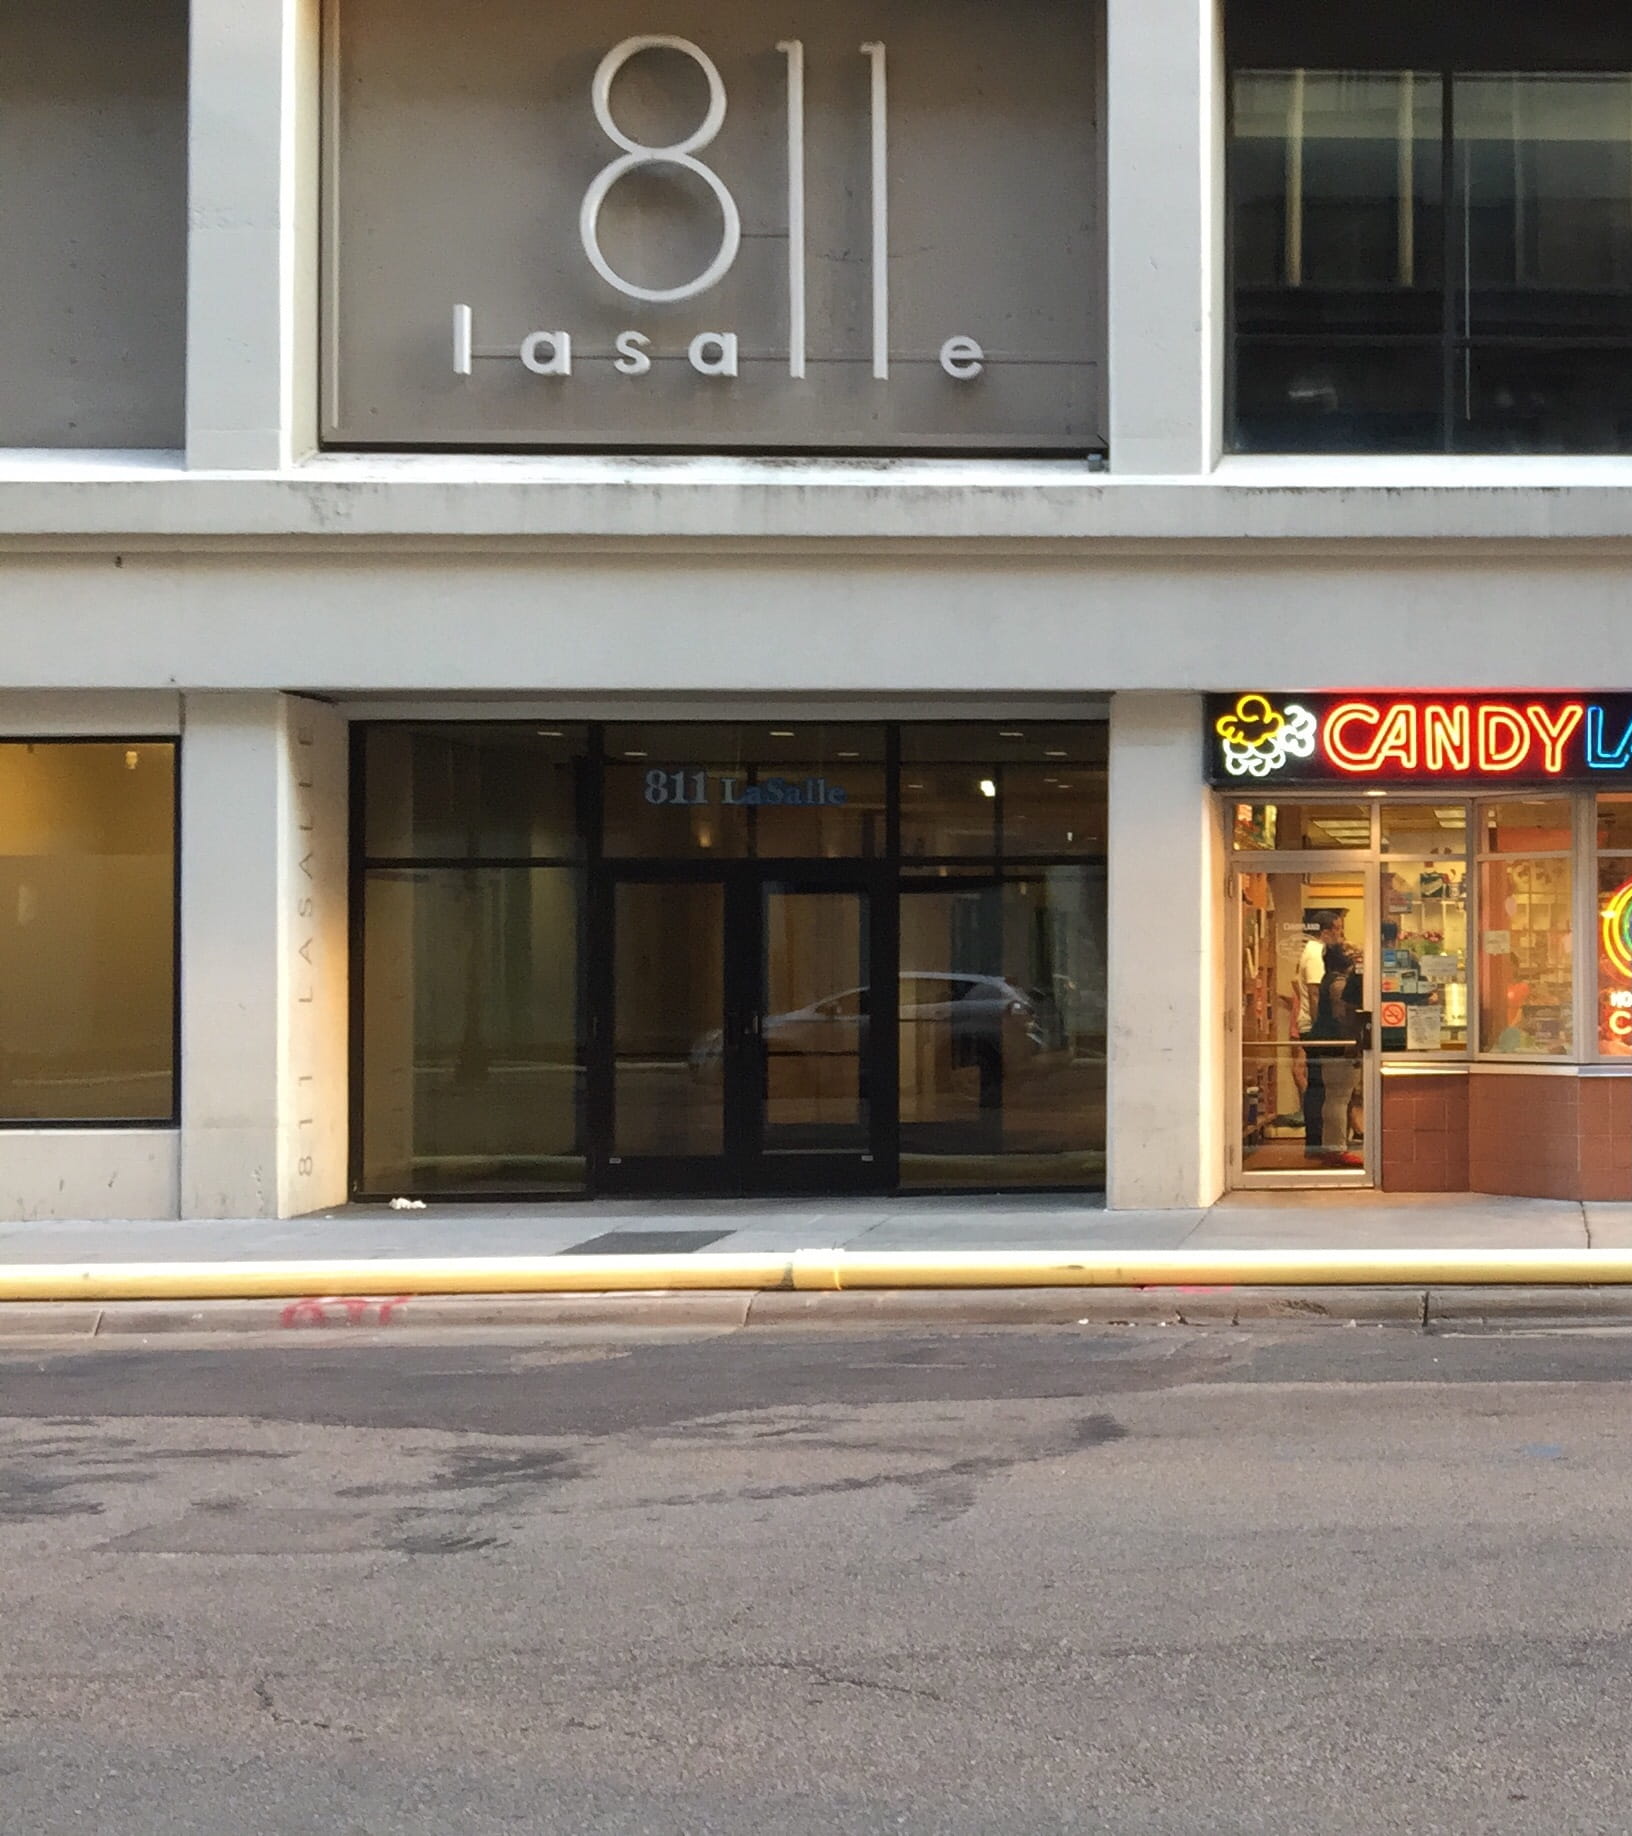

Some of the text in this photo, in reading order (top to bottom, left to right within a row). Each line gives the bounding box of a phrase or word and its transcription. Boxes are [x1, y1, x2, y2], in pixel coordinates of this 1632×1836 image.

[579, 33, 889, 379] 811
[298, 727, 313, 1178] 811 LASALLE
[645, 769, 848, 806] 811 LaSalle
